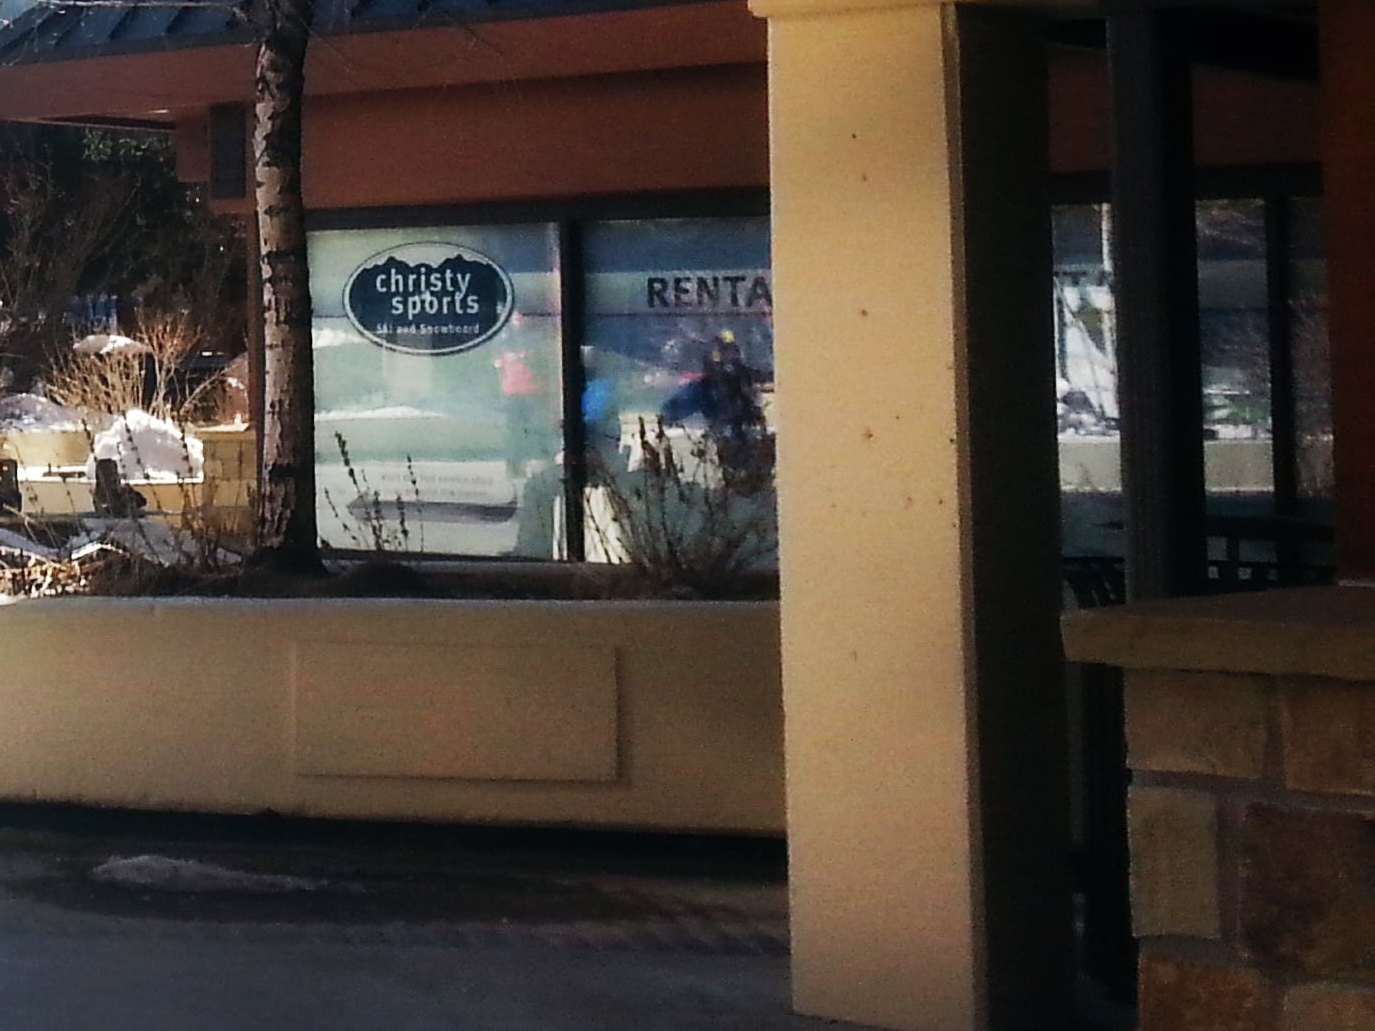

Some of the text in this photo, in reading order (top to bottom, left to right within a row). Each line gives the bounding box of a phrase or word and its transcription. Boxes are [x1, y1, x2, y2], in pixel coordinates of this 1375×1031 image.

[375, 267, 471, 299] christy
[390, 290, 480, 320] sports
[395, 322, 416, 334] and
[419, 322, 481, 335] Snowboard
